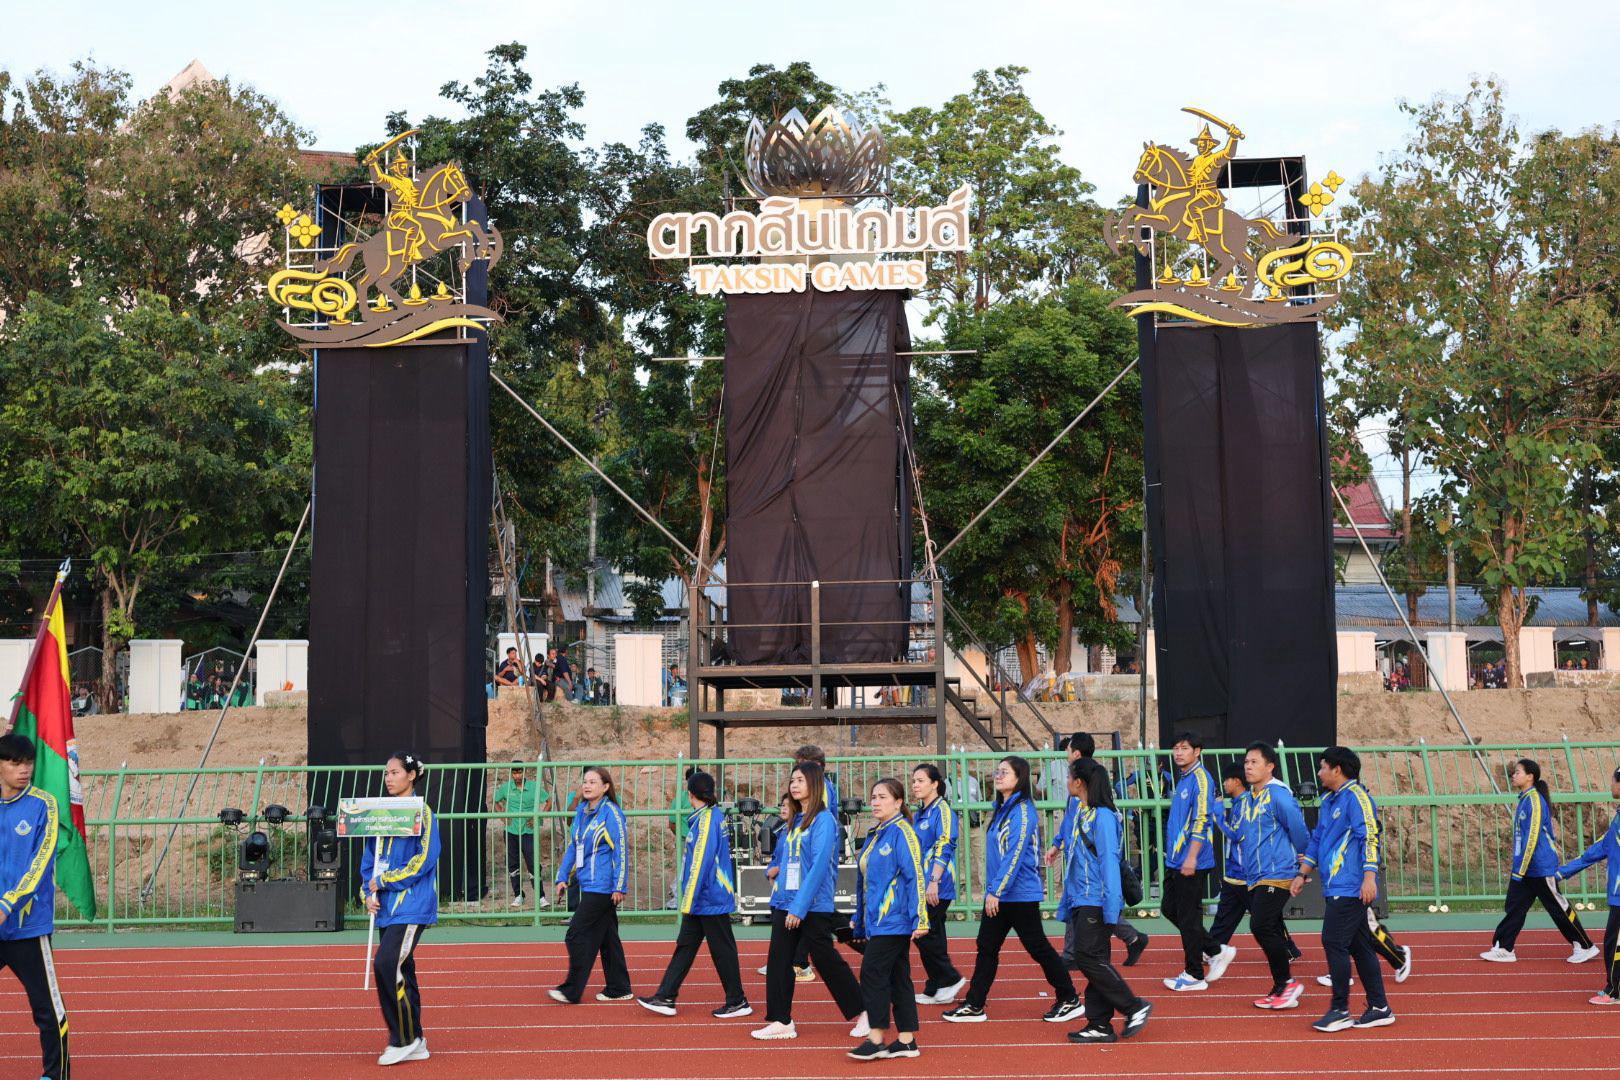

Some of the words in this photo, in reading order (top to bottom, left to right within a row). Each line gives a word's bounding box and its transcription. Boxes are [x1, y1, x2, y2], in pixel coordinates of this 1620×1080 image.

[649, 185, 970, 255] ตากสินเกมส์
[693, 266, 803, 291] TAKSIN
[814, 263, 925, 289] GAMES
